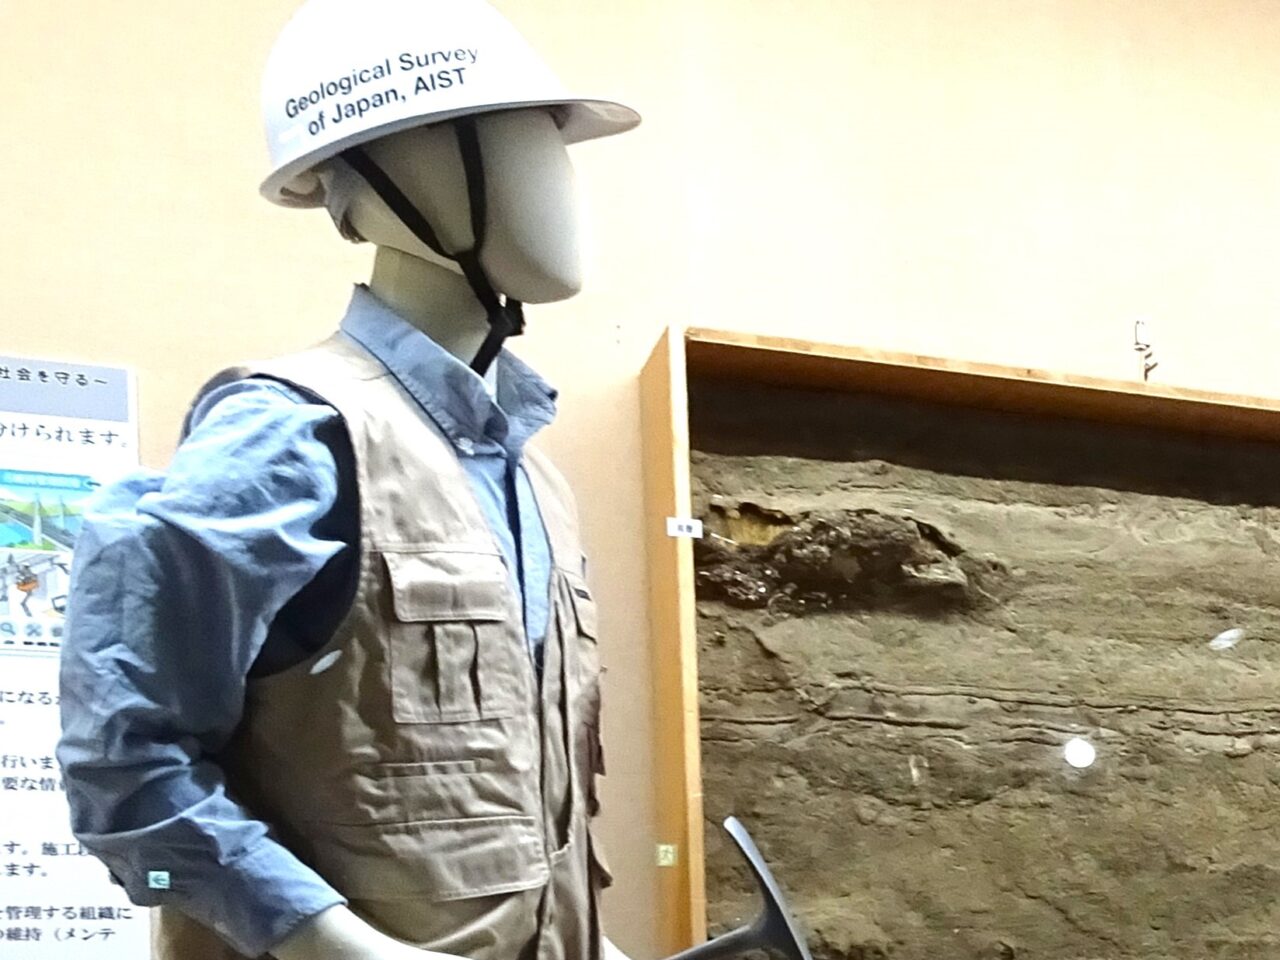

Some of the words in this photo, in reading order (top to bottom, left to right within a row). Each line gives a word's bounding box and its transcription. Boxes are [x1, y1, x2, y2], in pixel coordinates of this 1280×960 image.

[285, 58, 392, 119] Geological
[399, 48, 479, 73] Survey
[307, 115, 326, 137] of
[333, 88, 407, 124] Japan,
[414, 66, 468, 94] AIST
[0, 689, 61, 705] になる
[1, 755, 60, 770] 行いま
[0, 841, 90, 857] す。施工
[0, 863, 49, 878] ます。
